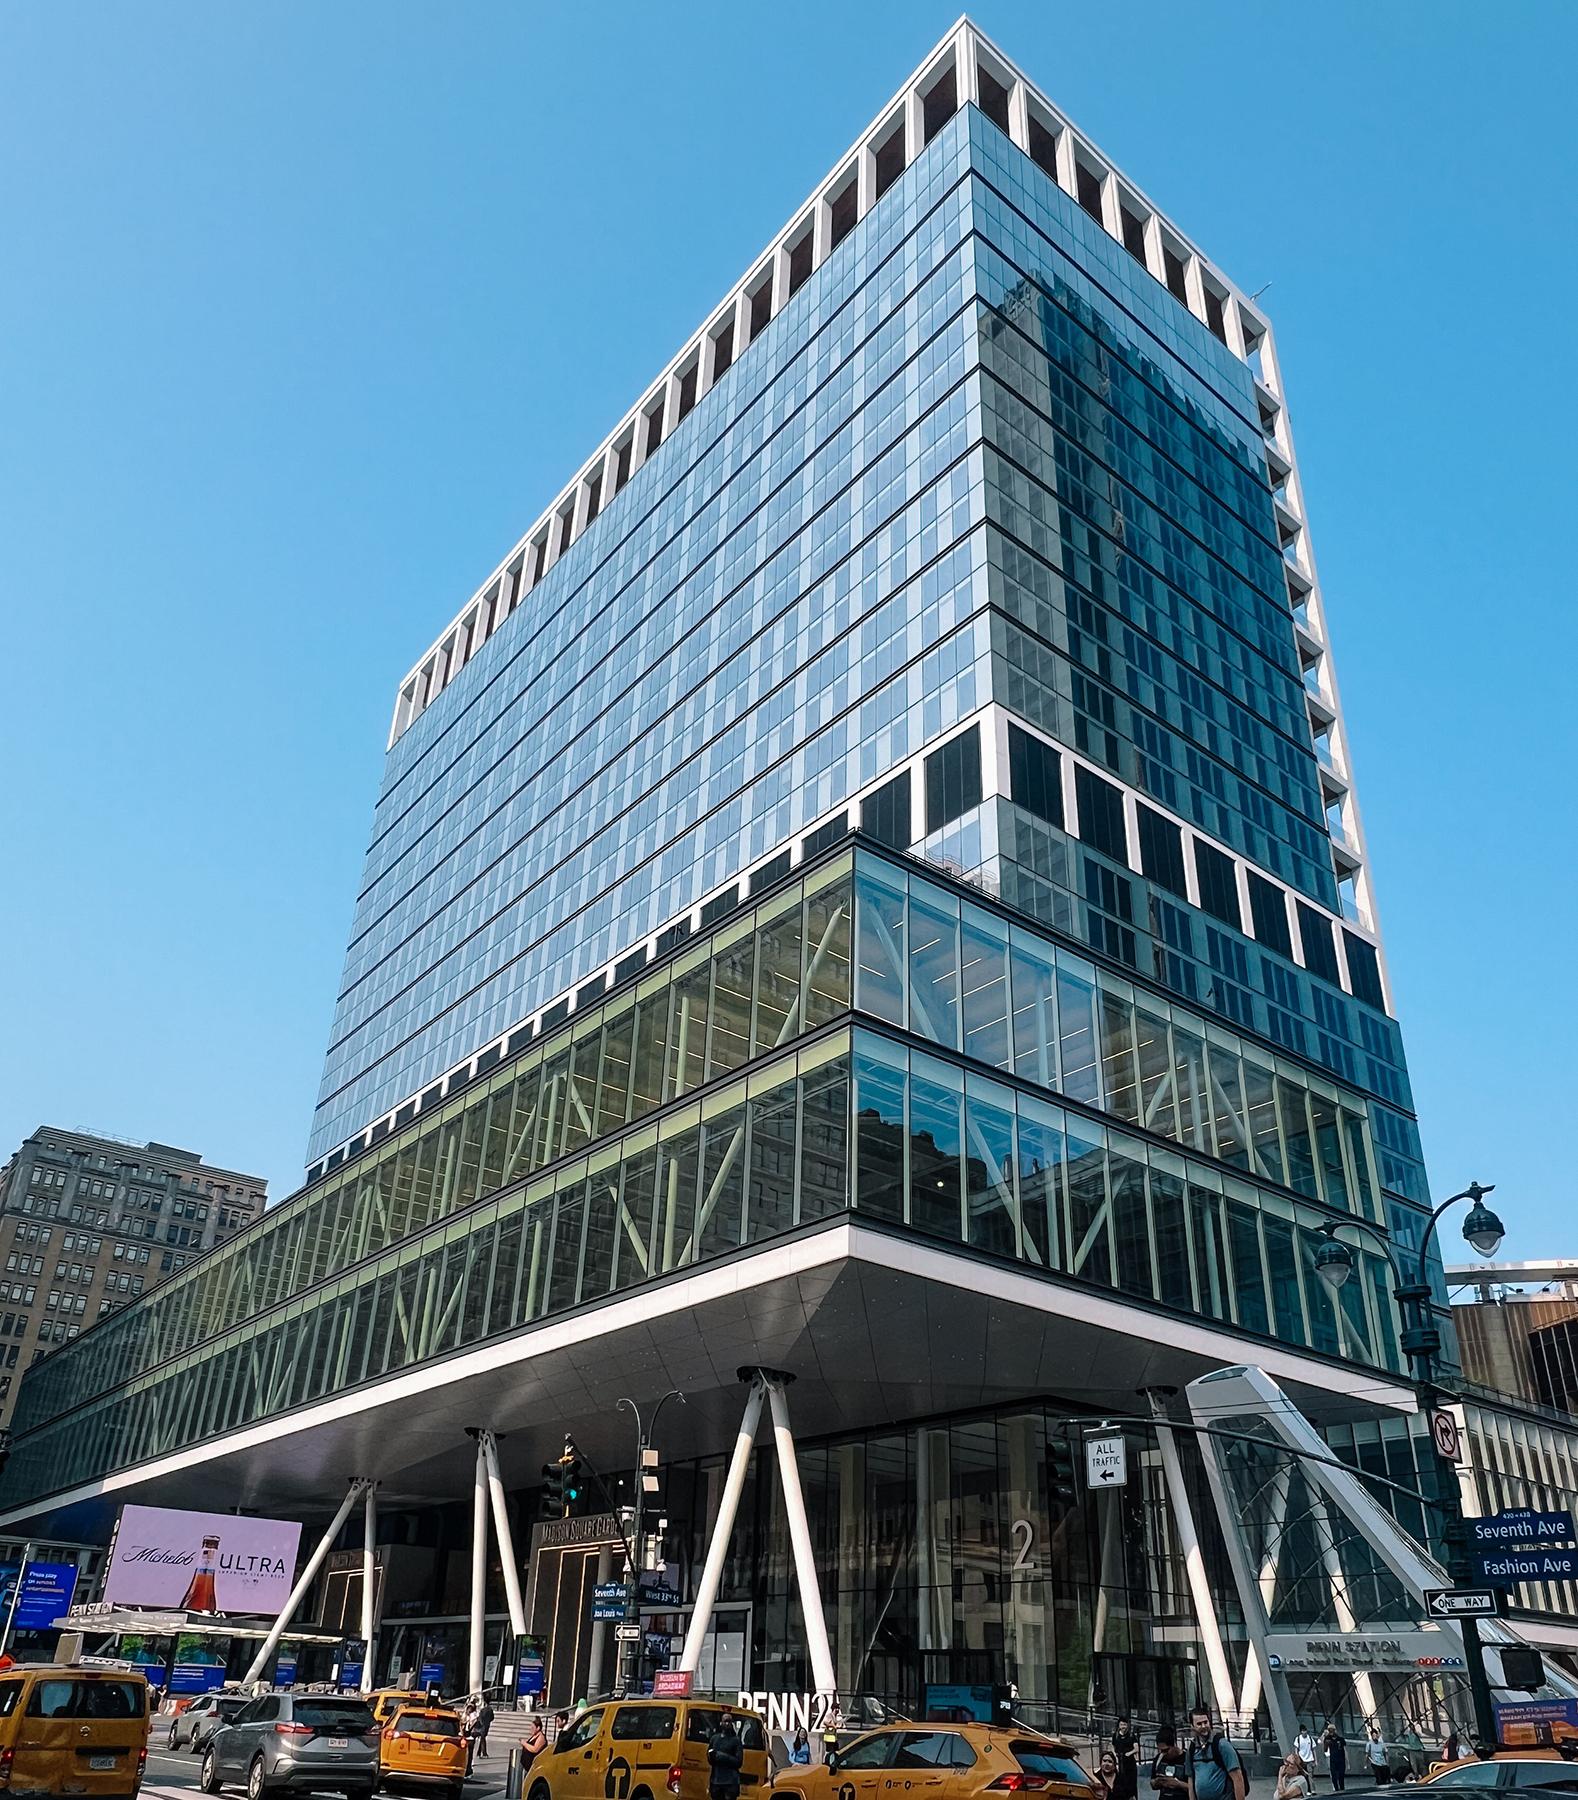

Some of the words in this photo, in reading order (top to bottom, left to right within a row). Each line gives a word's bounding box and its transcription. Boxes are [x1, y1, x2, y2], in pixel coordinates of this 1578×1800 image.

[1096, 1443, 1115, 1455] ALL
[1092, 1456, 1121, 1467] TRAFFIC
[542, 1524, 570, 1541] MADISON
[570, 1520, 597, 1540] SQUARE
[1475, 1521, 1533, 1539] Seventh
[1538, 1521, 1566, 1535] Ave
[1011, 1519, 1035, 1570] 2
[122, 1546, 196, 1567] Michelob
[219, 1553, 285, 1574] ULTRA
[1483, 1558, 1539, 1575] Fashion
[1543, 1557, 1572, 1573] Ave
[594, 1588, 615, 1598] Seventh
[616, 1588, 627, 1598] Ave
[645, 1590, 660, 1600] West
[673, 1594, 680, 1604] St
[1438, 1598, 1456, 1608] ONE
[1464, 1597, 1485, 1607] WAY
[1306, 1640, 1341, 1653] PENN
[1345, 1640, 1402, 1653] STATION
